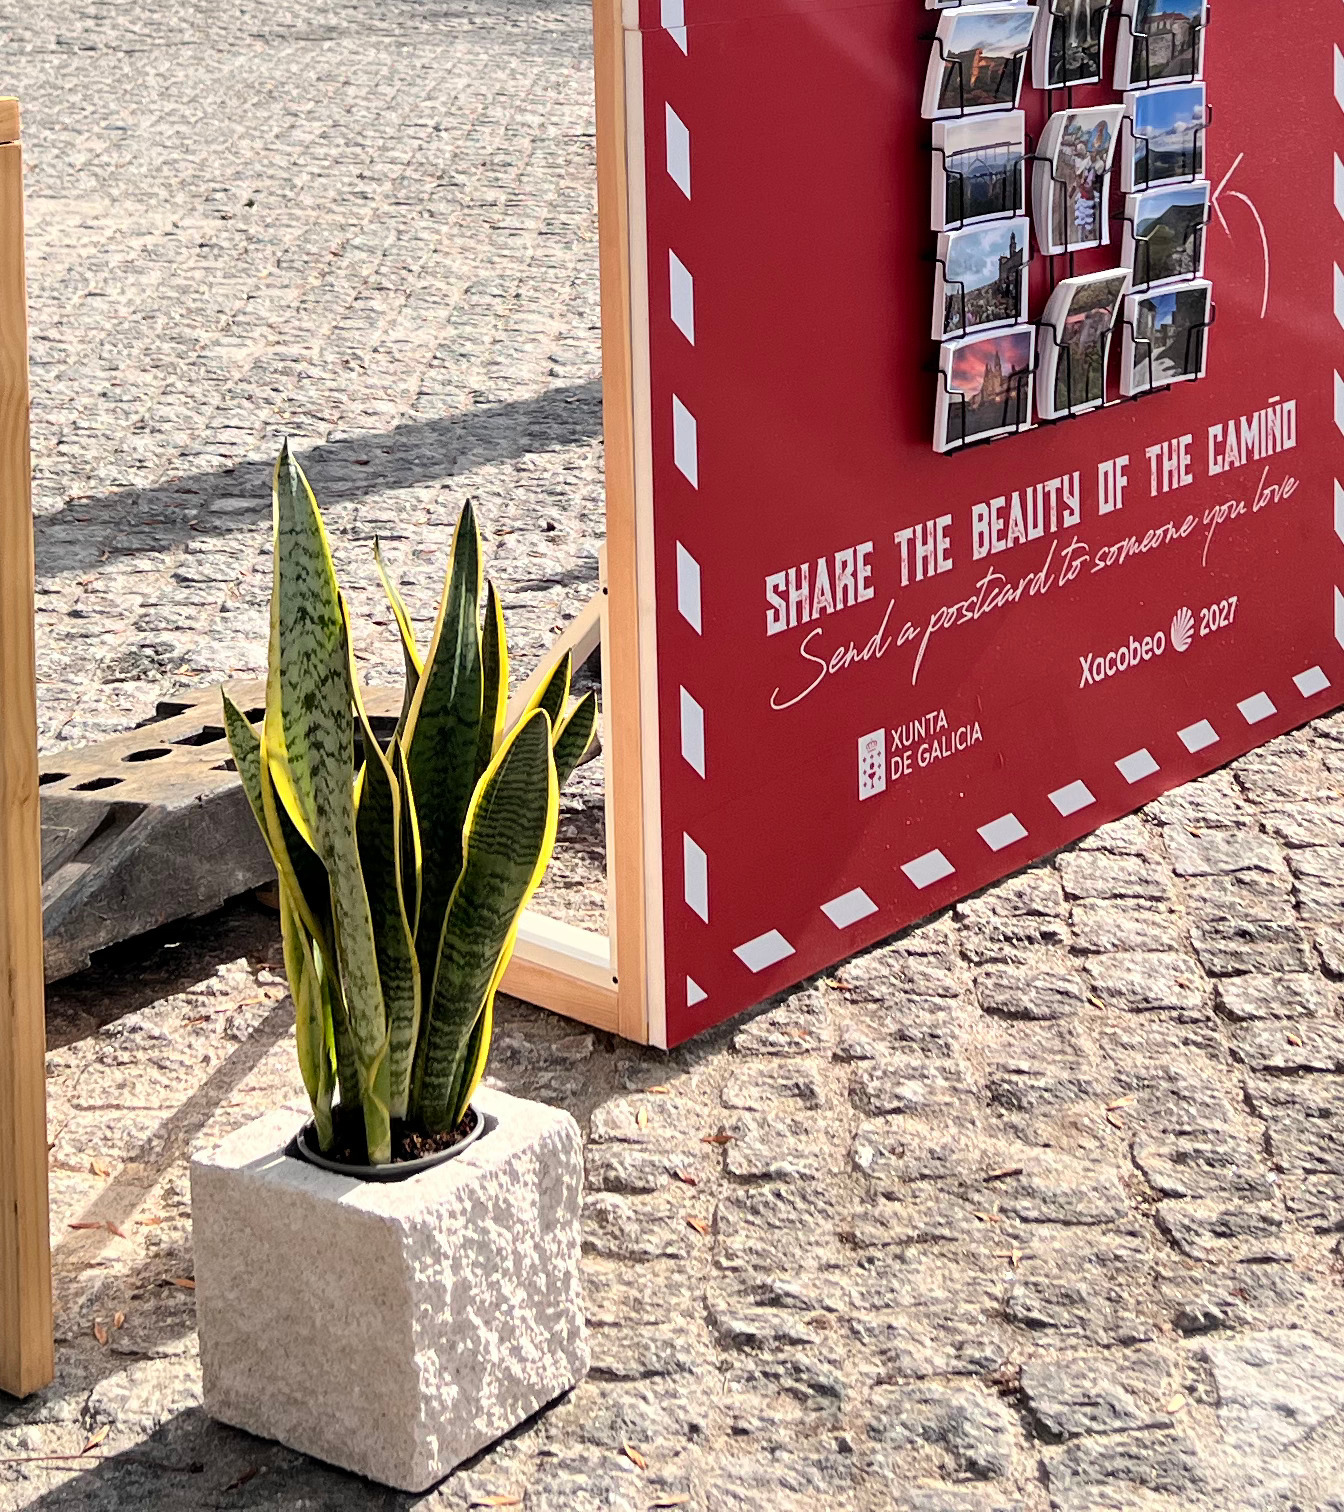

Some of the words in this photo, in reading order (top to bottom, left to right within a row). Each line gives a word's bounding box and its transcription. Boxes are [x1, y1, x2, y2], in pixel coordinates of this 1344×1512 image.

[765, 541, 874, 636] SHARE
[893, 513, 953, 587] THE
[971, 471, 1080, 560] BEAUTY
[1098, 455, 1129, 516] OF
[1145, 434, 1193, 497] THE
[1208, 396, 1297, 476] CAMIÑO
[770, 598, 895, 710] Send
[896, 621, 920, 646] a
[911, 539, 1057, 685] postcard
[1059, 535, 1090, 586] to
[1090, 514, 1199, 573] someone
[1202, 499, 1247, 567] you
[1252, 465, 1299, 512] love
[1079, 631, 1166, 688] Xacobeo
[1199, 595, 1238, 637] 2027
[891, 709, 948, 752] XUNTA
[891, 750, 913, 781] DE
[917, 721, 983, 767] GALICIA
